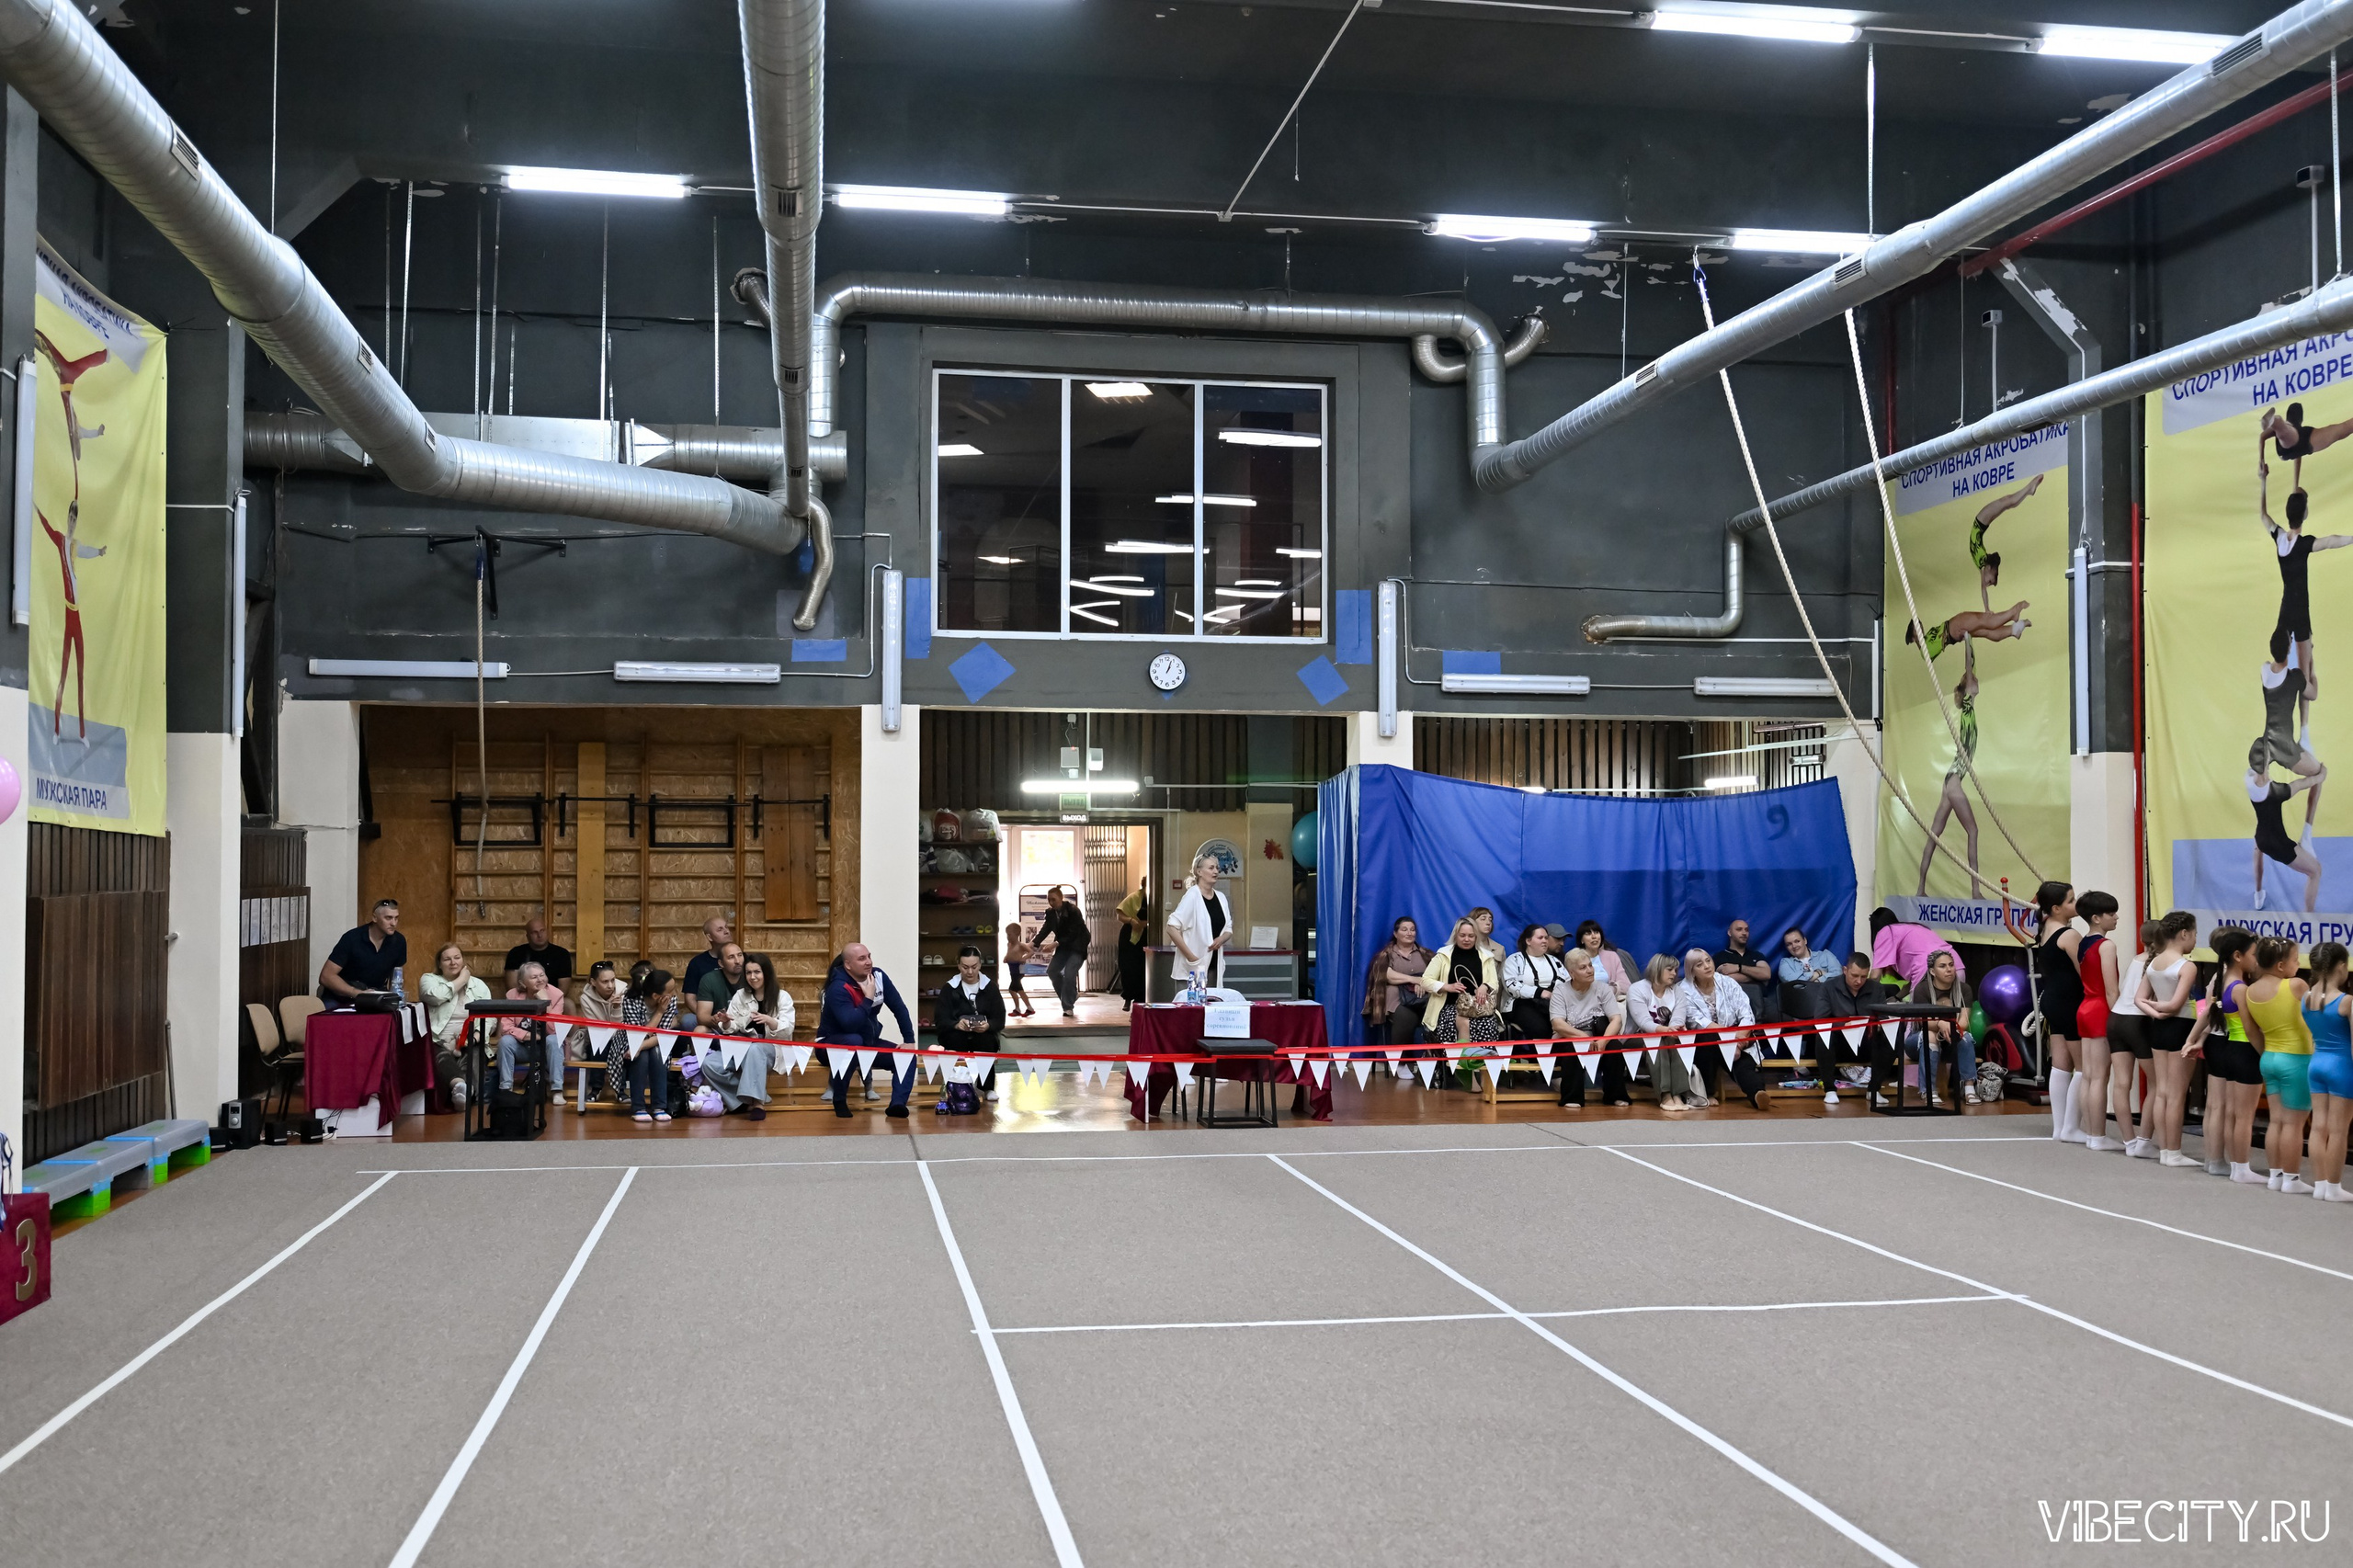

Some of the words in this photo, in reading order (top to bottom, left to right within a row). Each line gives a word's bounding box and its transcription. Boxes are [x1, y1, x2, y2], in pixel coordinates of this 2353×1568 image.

[2172, 343, 2298, 401] СПОРТИВНАЯ
[2253, 379, 2279, 406] НА
[2285, 353, 2353, 396] КОВРЕ
[1901, 447, 1982, 490] СПОРТИВНАЯ
[1952, 477, 1970, 497] НА
[1972, 461, 2015, 492] КОВРЕ
[36, 777, 80, 805] МУЖСКАЯ
[81, 787, 108, 811] ПАРА
[1918, 903, 1983, 925] ЖЕНСКАЯ
[15, 1218, 38, 1302] 3
